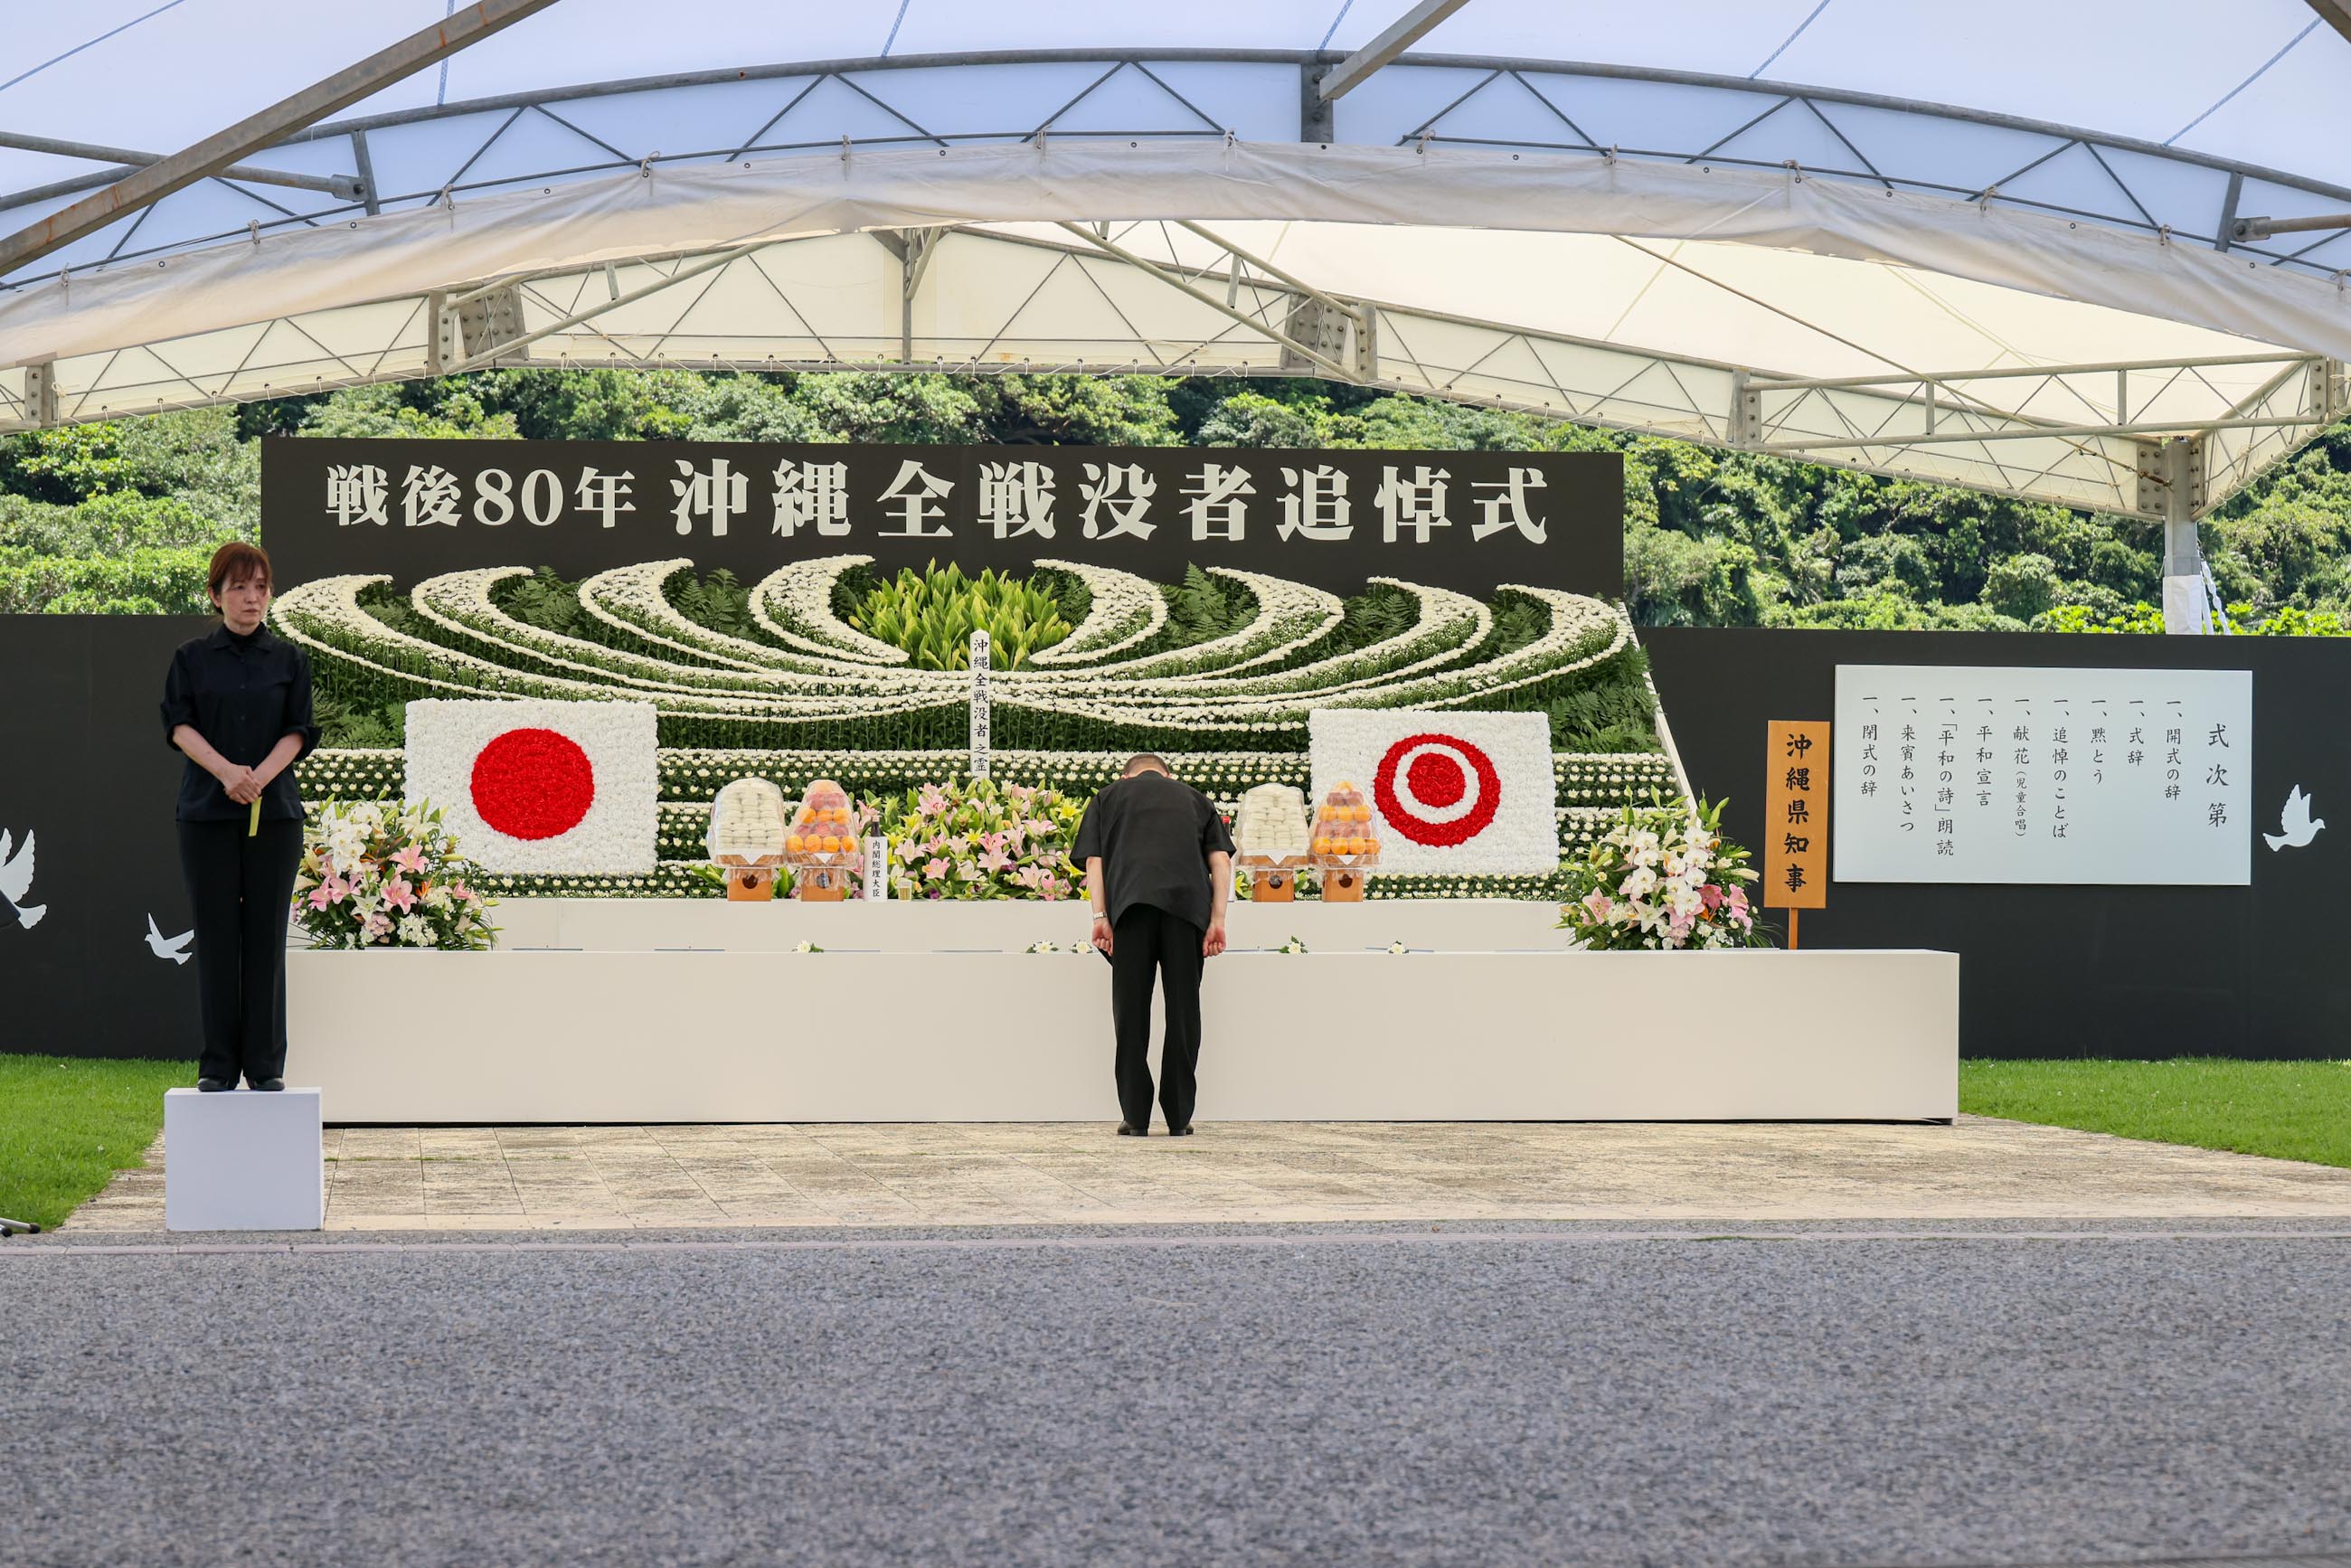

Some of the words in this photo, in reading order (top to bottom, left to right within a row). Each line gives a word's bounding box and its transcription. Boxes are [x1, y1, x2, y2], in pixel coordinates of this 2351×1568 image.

[326, 464, 636, 528] 戦後80年
[669, 458, 1548, 544] 沖縄全戦没者追悼式
[973, 638, 989, 771] 沖縄全戦没者之霊
[1860, 696, 1879, 798] 一、閉式の辞
[1976, 698, 1994, 808] 一、平和宣言
[2091, 700, 2108, 785] 一、黙とう
[2128, 700, 2145, 767] 一、式辞
[2165, 701, 2183, 801] 一、開式の辞
[1784, 733, 1813, 893] 沖縄県知事
[1900, 697, 1918, 833] 一、来賓あいさつ
[1934, 697, 1958, 856] 一、「平和の詩」朗読
[2052, 699, 2070, 838] 一、追悼のことば
[2205, 723, 2230, 828] 式次第
[872, 840, 882, 898] 内閣総理大臣
